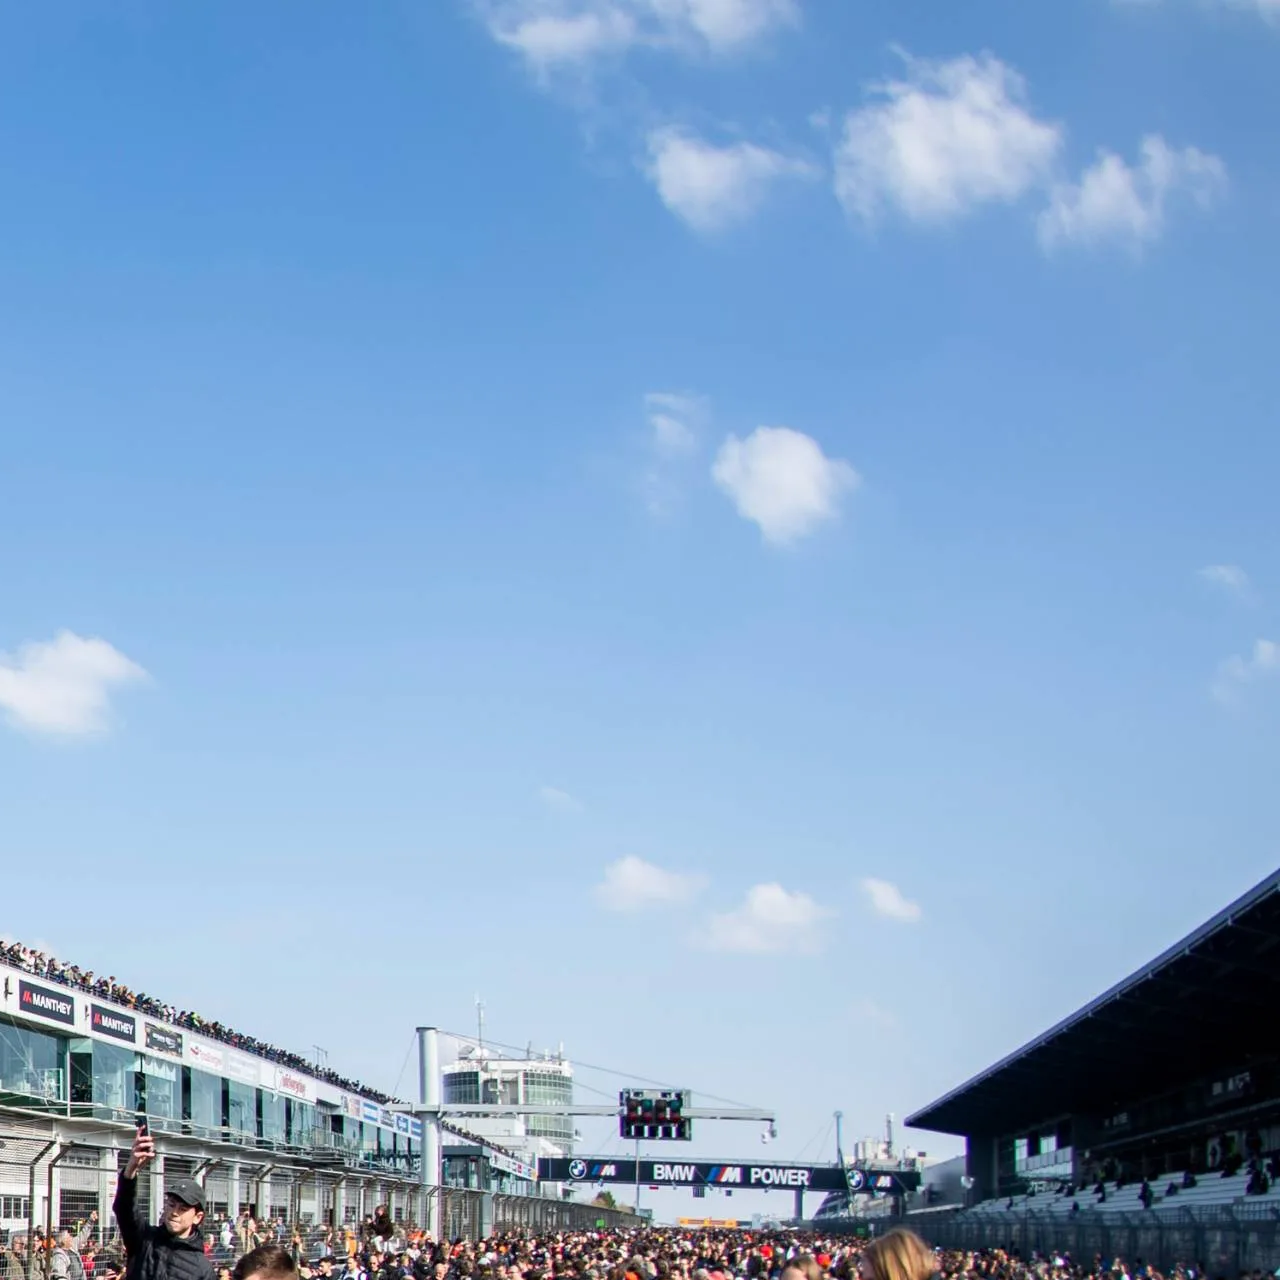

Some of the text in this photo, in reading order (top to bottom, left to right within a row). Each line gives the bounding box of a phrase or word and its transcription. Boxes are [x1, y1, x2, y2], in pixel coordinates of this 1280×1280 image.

[32, 993, 72, 1016] MANTHEY
[101, 1013, 134, 1036] MANTHEY
[653, 1164, 694, 1182] BMW
[750, 1167, 810, 1186] POWER
